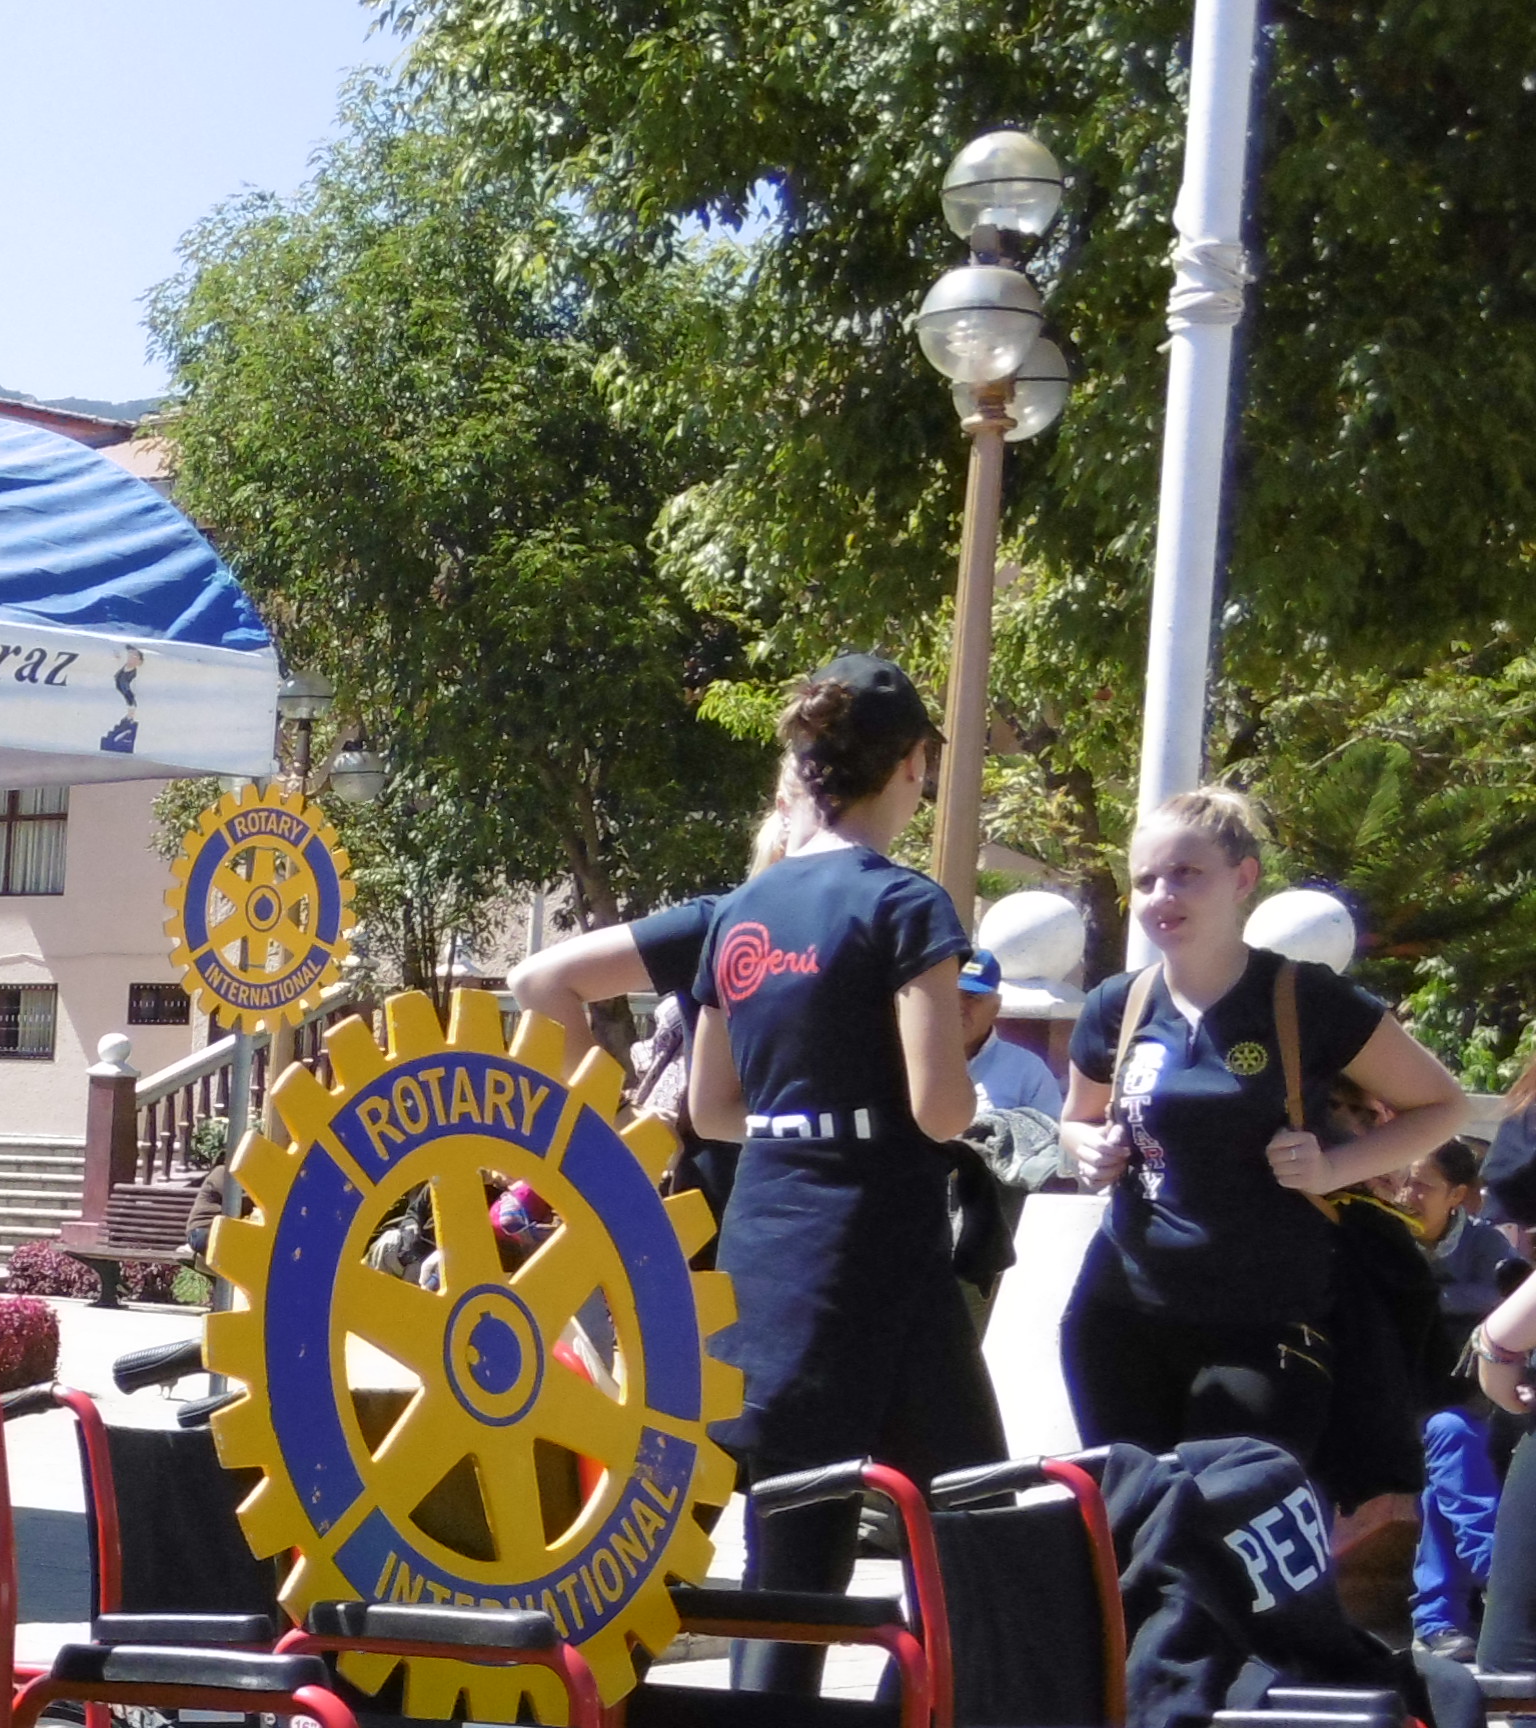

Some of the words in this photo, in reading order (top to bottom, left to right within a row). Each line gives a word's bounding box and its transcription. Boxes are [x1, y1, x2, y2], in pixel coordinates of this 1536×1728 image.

[234, 812, 304, 840] ROTARY
[204, 958, 323, 1007] INTERNATIONAL
[354, 1065, 551, 1162] ROTARY
